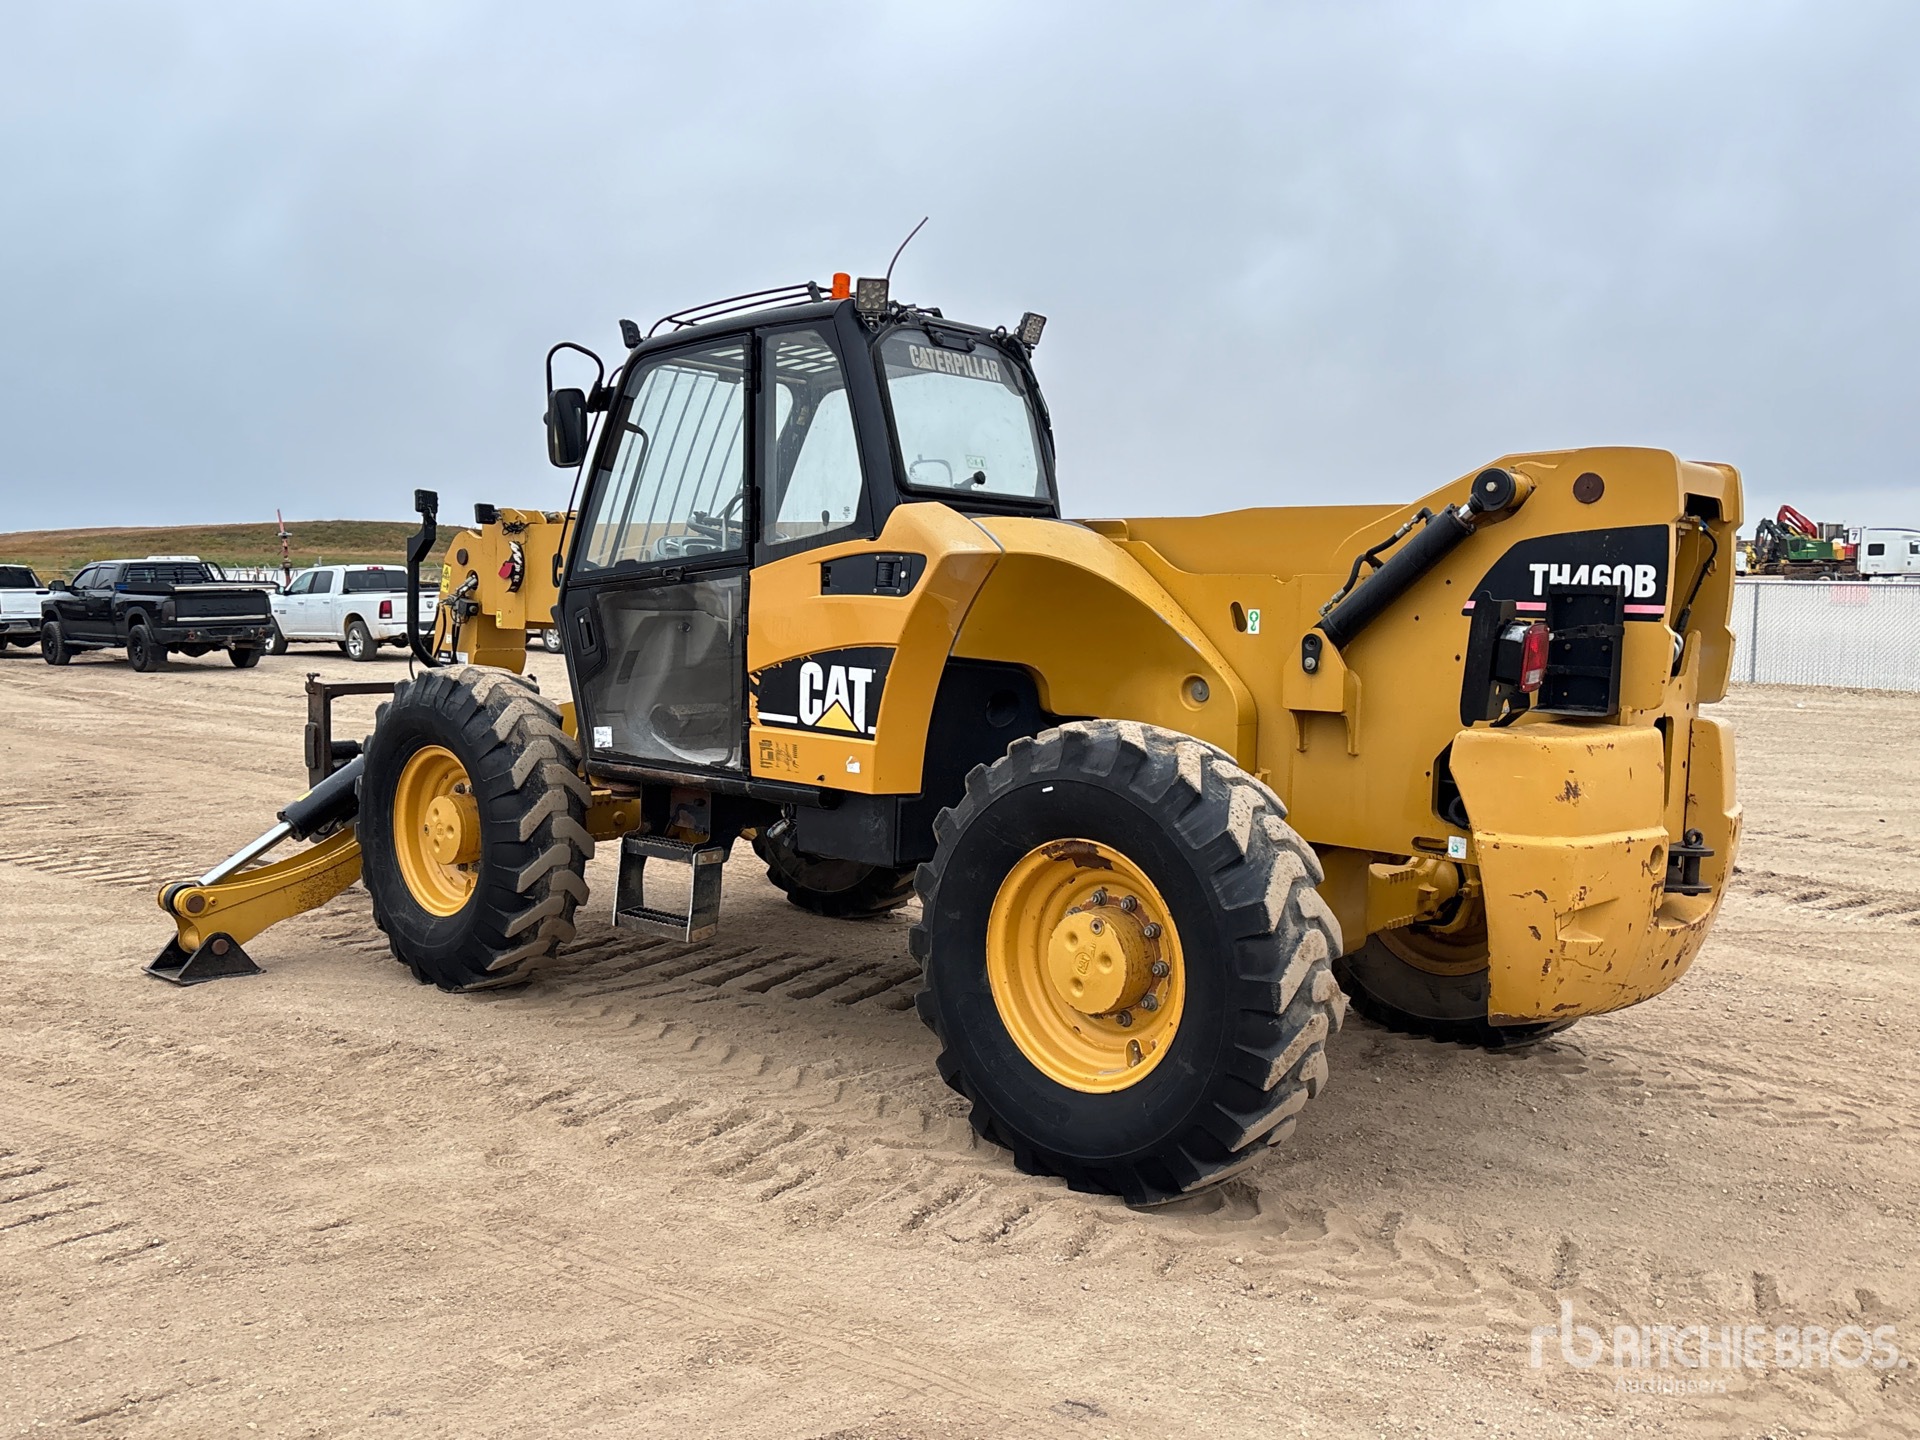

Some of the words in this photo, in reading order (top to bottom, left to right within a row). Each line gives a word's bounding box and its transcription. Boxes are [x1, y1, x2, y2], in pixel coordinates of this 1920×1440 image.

[909, 344, 1001, 381] CATERPILLAR
[1851, 532, 1859, 541] 7
[1529, 563, 1657, 598] TH460B
[799, 661, 873, 733] CAT
